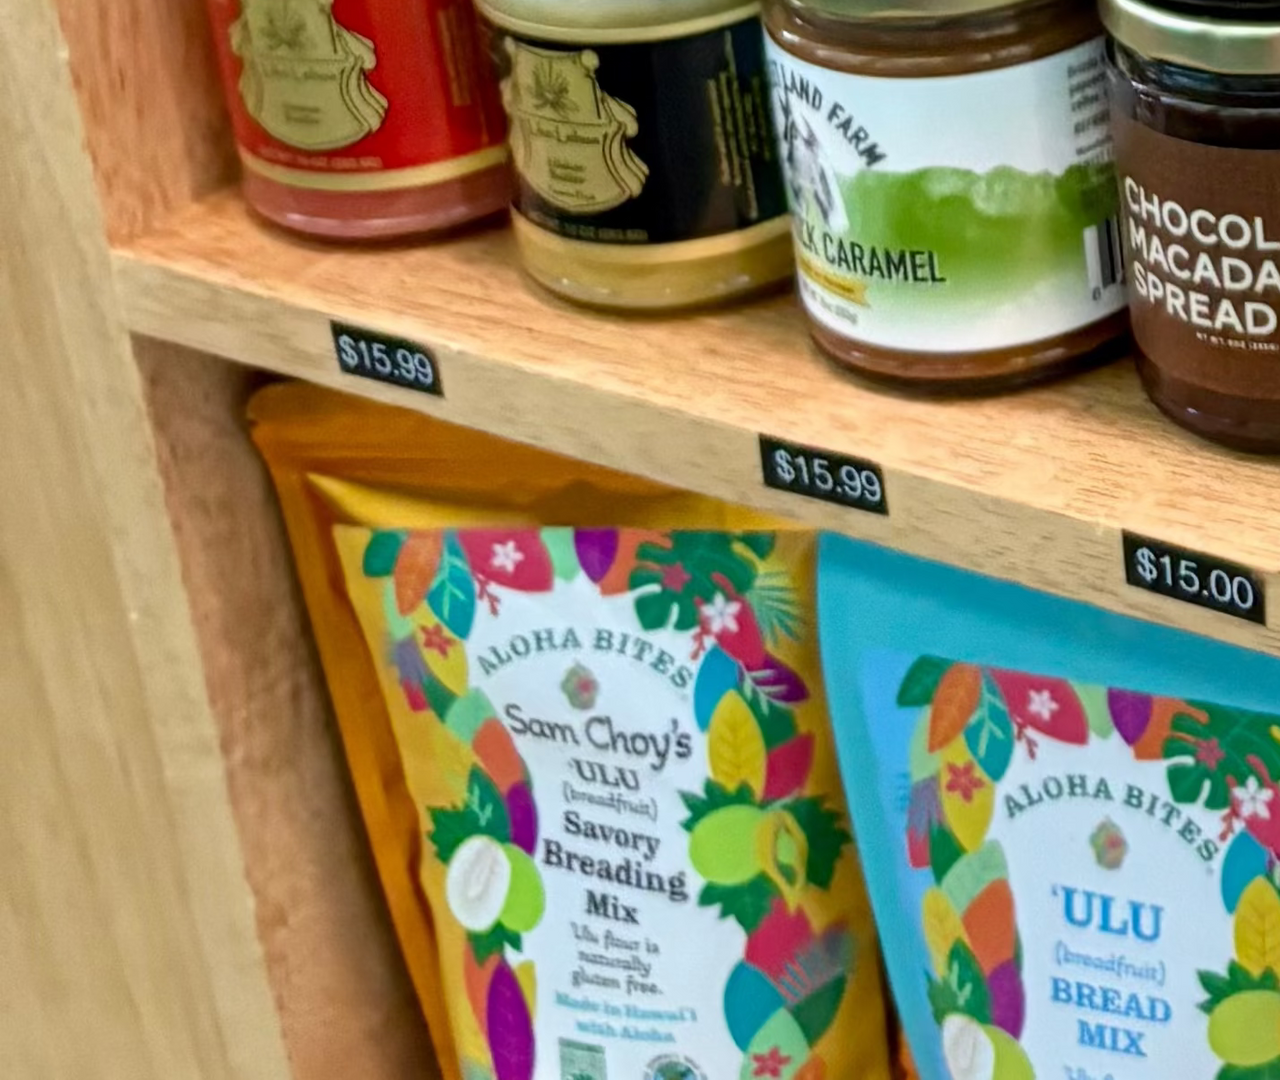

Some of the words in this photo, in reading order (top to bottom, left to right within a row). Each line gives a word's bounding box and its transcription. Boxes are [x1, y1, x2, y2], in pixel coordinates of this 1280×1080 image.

[827, 101, 888, 168] FARM
[823, 232, 947, 283] CARAMEL
[1133, 260, 1278, 336] SPREAD
[338, 333, 434, 386] $15.99
[774, 449, 882, 503] $15.99
[1135, 546, 1255, 611] $15.00
[475, 626, 583, 677] ALOHA
[593, 626, 693, 691] BITES
[504, 703, 579, 745] Sam
[584, 716, 692, 774] Choy's
[563, 811, 660, 861] Savory
[1003, 773, 1114, 819] ALOHA
[1125, 783, 1219, 863] BITES
[542, 839, 690, 903] Breading
[584, 891, 639, 926] Mix
[1055, 939, 1167, 986] (breadfruit)
[1050, 976, 1173, 1023] BREAD
[1077, 1019, 1148, 1058] MIX
